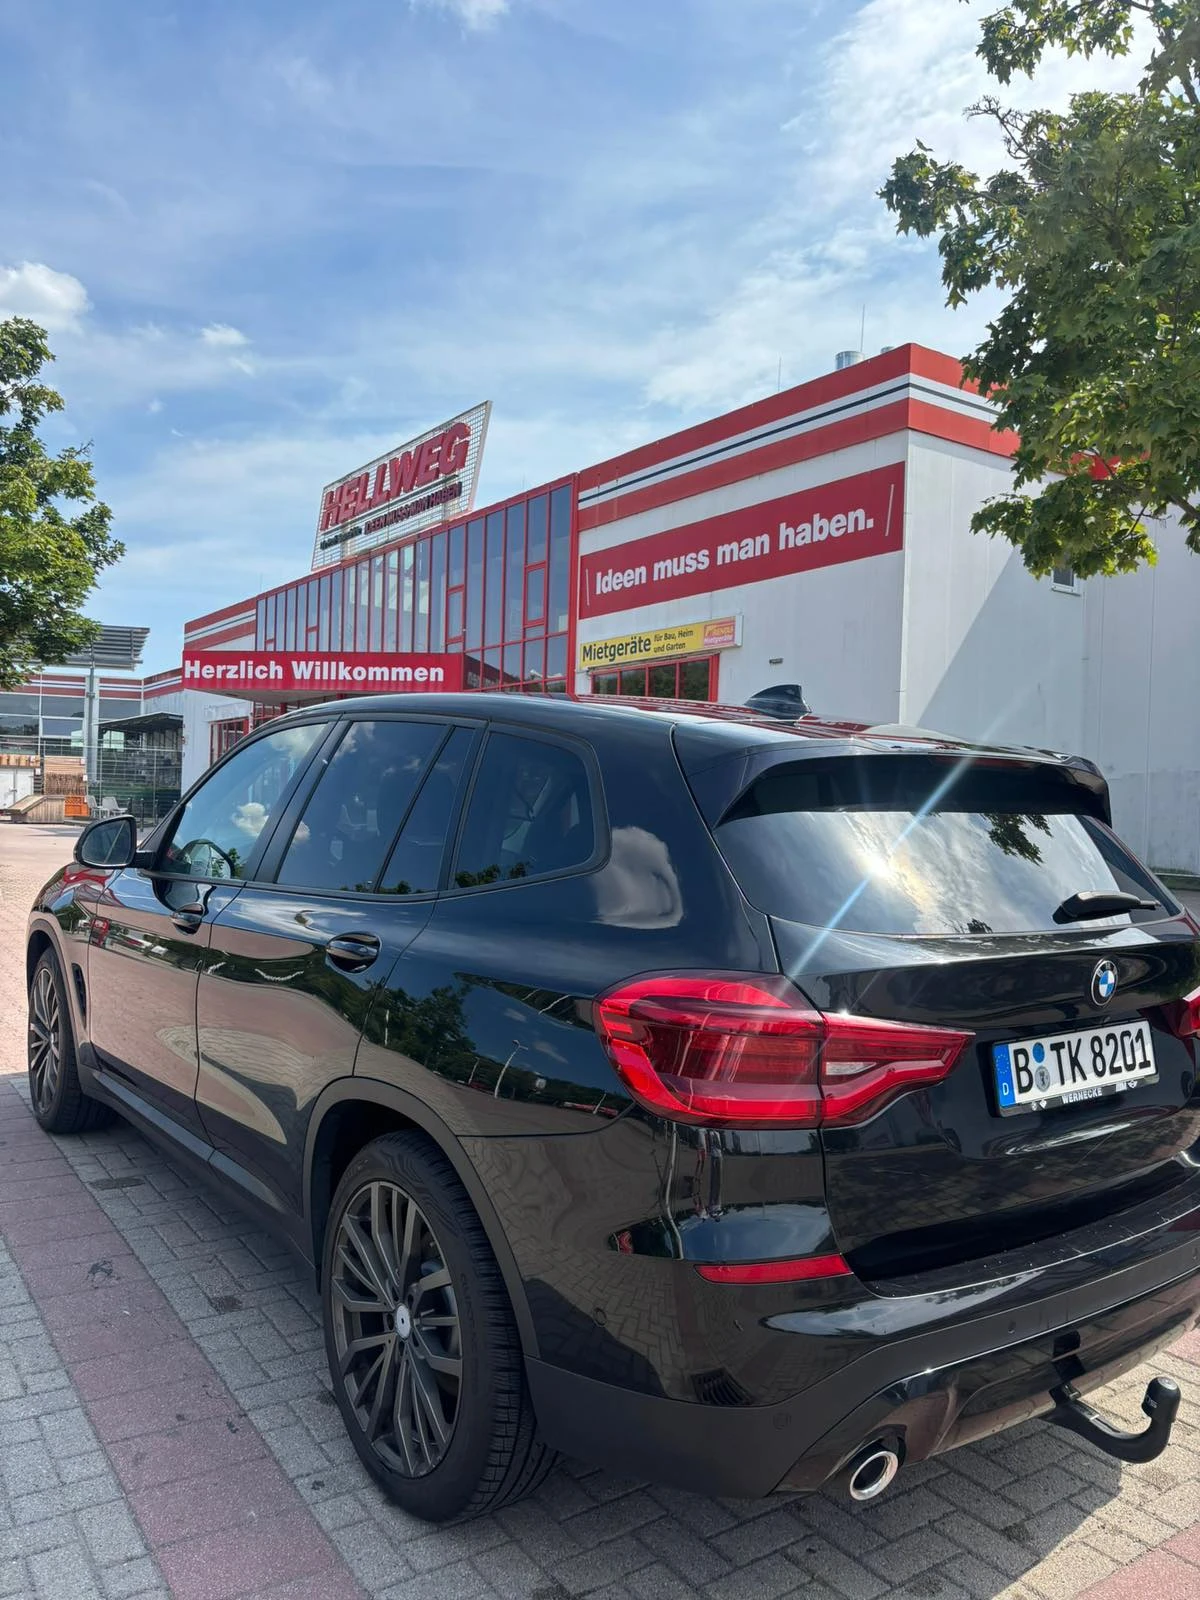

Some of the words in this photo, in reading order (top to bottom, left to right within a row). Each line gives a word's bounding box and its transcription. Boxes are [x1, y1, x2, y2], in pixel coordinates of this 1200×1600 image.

[320, 423, 471, 531] HELLWEG
[364, 514, 387, 535] IDEEN
[387, 503, 410, 527] MUSS
[595, 566, 647, 595] Ideen
[653, 549, 710, 581] muss
[717, 533, 770, 565] man
[779, 508, 874, 551] haben.
[582, 636, 652, 662] Mietgeräte
[653, 634, 663, 642] für
[663, 632, 677, 641] Bau,
[677, 629, 694, 638] Heim
[653, 645, 665, 653] und
[665, 642, 686, 651] Garten
[184, 660, 283, 680] Herzlich
[291, 660, 444, 683] Willkommen
[1013, 1047, 1034, 1094] B
[1050, 1038, 1087, 1086] TK
[1090, 1028, 1151, 1078] 8201
[1002, 1082, 1009, 1096] D
[1061, 1086, 1103, 1105] WERNECKE
